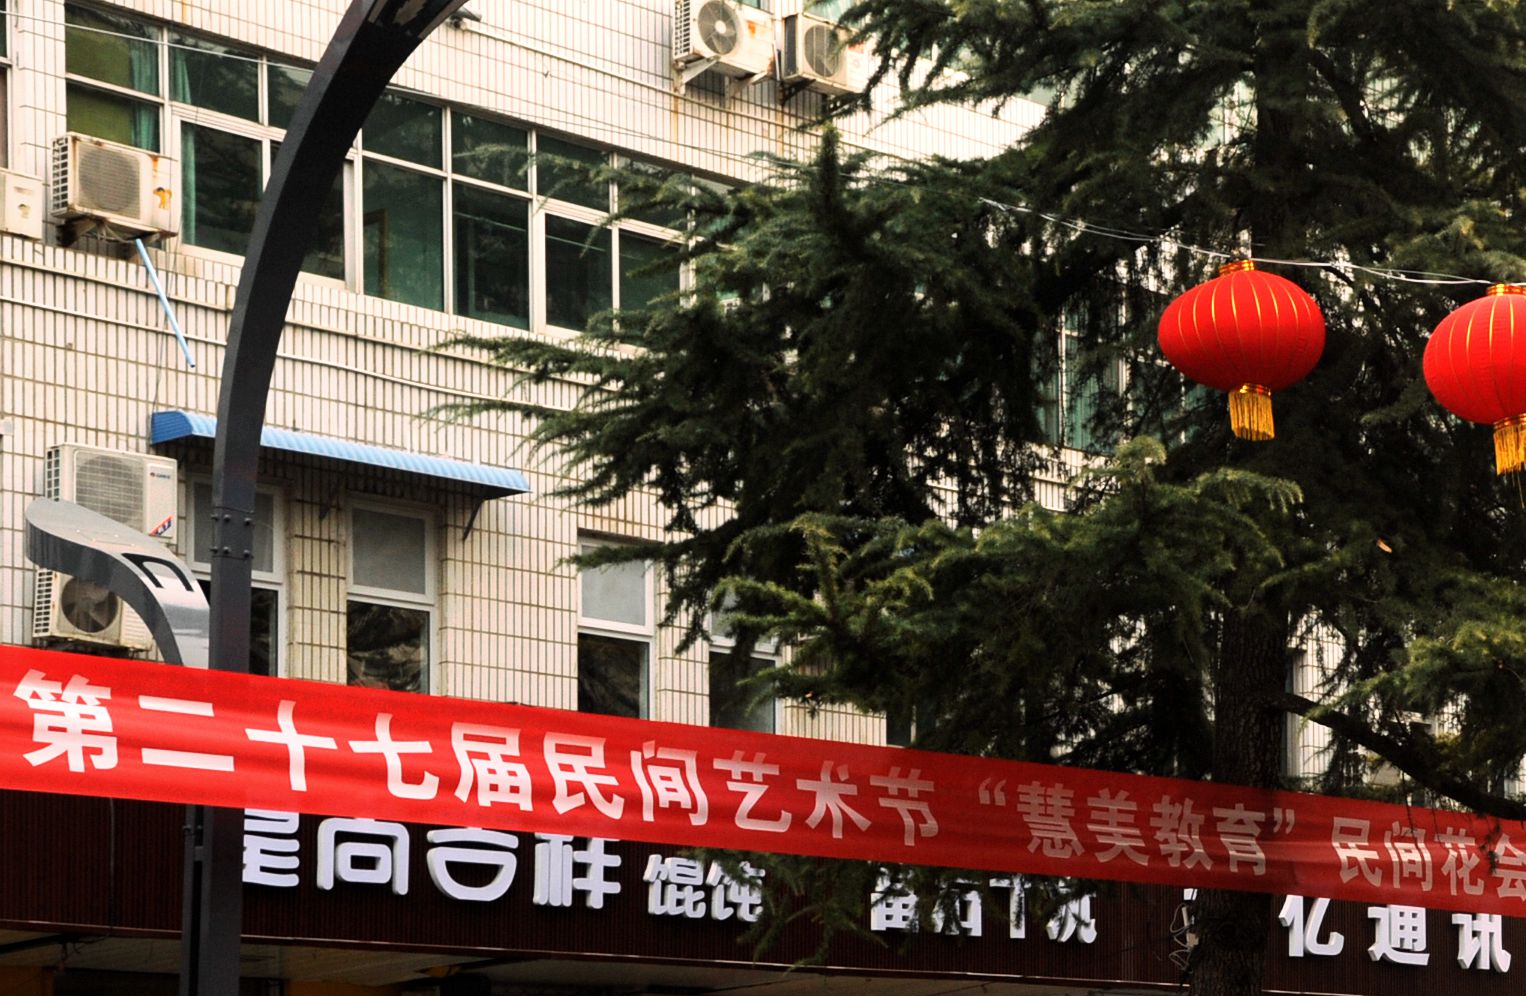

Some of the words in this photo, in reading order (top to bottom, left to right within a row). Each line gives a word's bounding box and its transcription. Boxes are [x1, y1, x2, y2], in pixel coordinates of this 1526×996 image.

[14, 668, 940, 848] 第二十七届民间艺术节
[1184, 888, 1512, 973] 亿通讯
